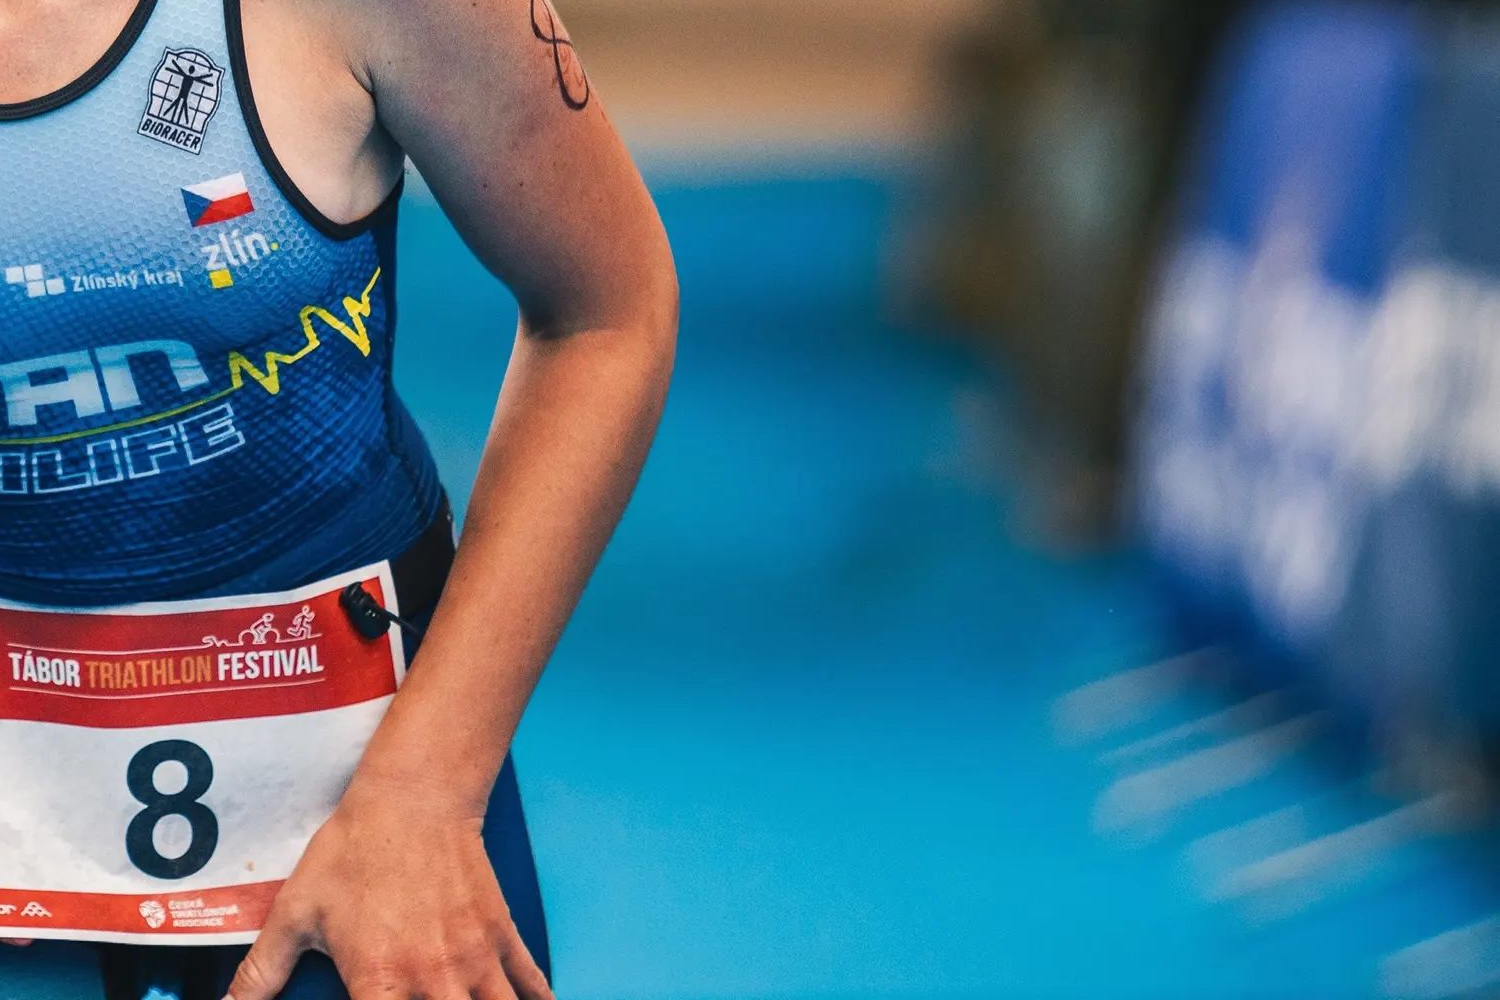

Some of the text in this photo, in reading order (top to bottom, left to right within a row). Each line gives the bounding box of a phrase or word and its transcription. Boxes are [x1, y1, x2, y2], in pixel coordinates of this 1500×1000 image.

[141, 118, 200, 150] BIORACER
[142, 267, 184, 288] kraj
[8, 645, 324, 689] TÁBOR TRIATHLON FESTIVAL
[126, 739, 219, 880] 8
